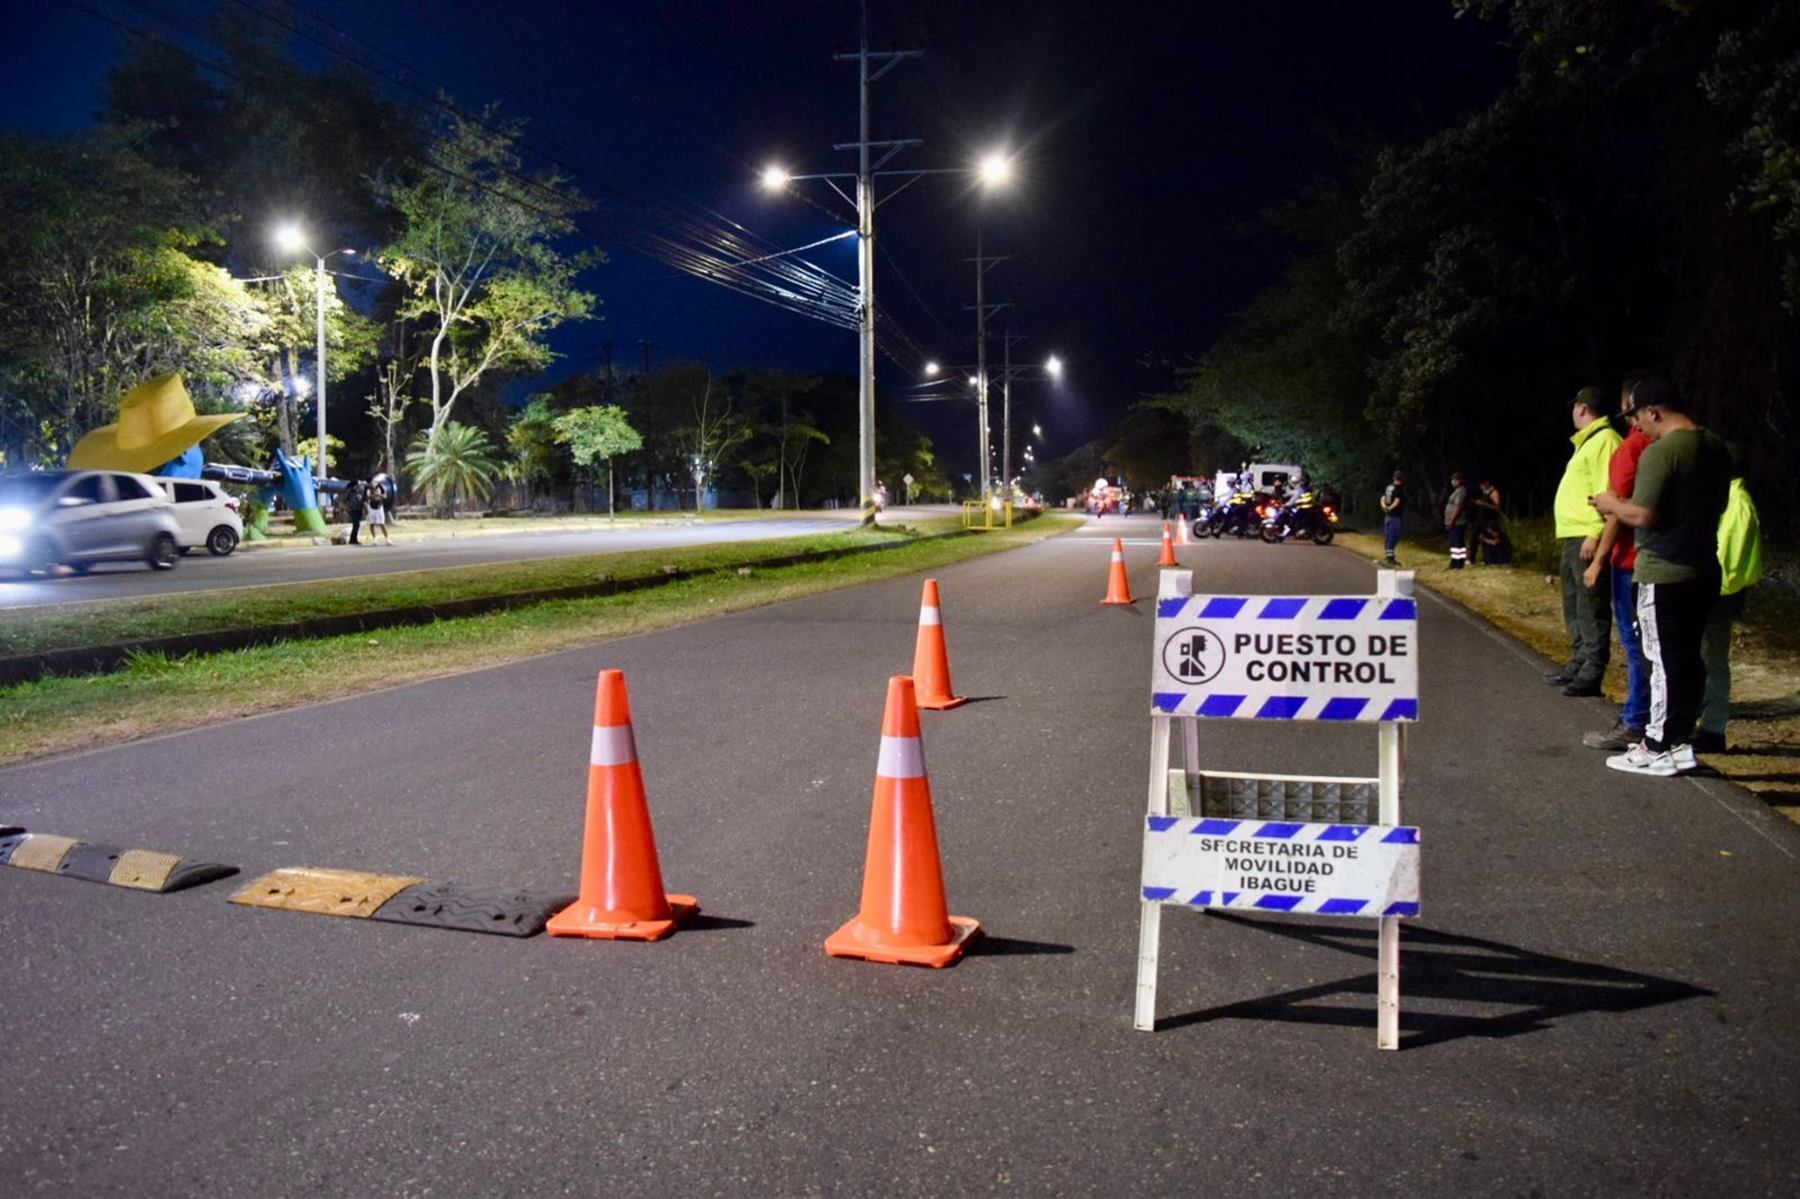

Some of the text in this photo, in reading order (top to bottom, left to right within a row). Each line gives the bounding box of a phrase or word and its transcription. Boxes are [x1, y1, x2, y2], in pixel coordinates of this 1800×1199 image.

[1234, 633, 1408, 656] PUESTO DE
[1246, 660, 1395, 684] CONTROL
[1200, 838, 1359, 860] SECRETARIA DE
[1225, 857, 1334, 876] MOVILIDAD
[1240, 876, 1316, 893] IBAGUÉ
